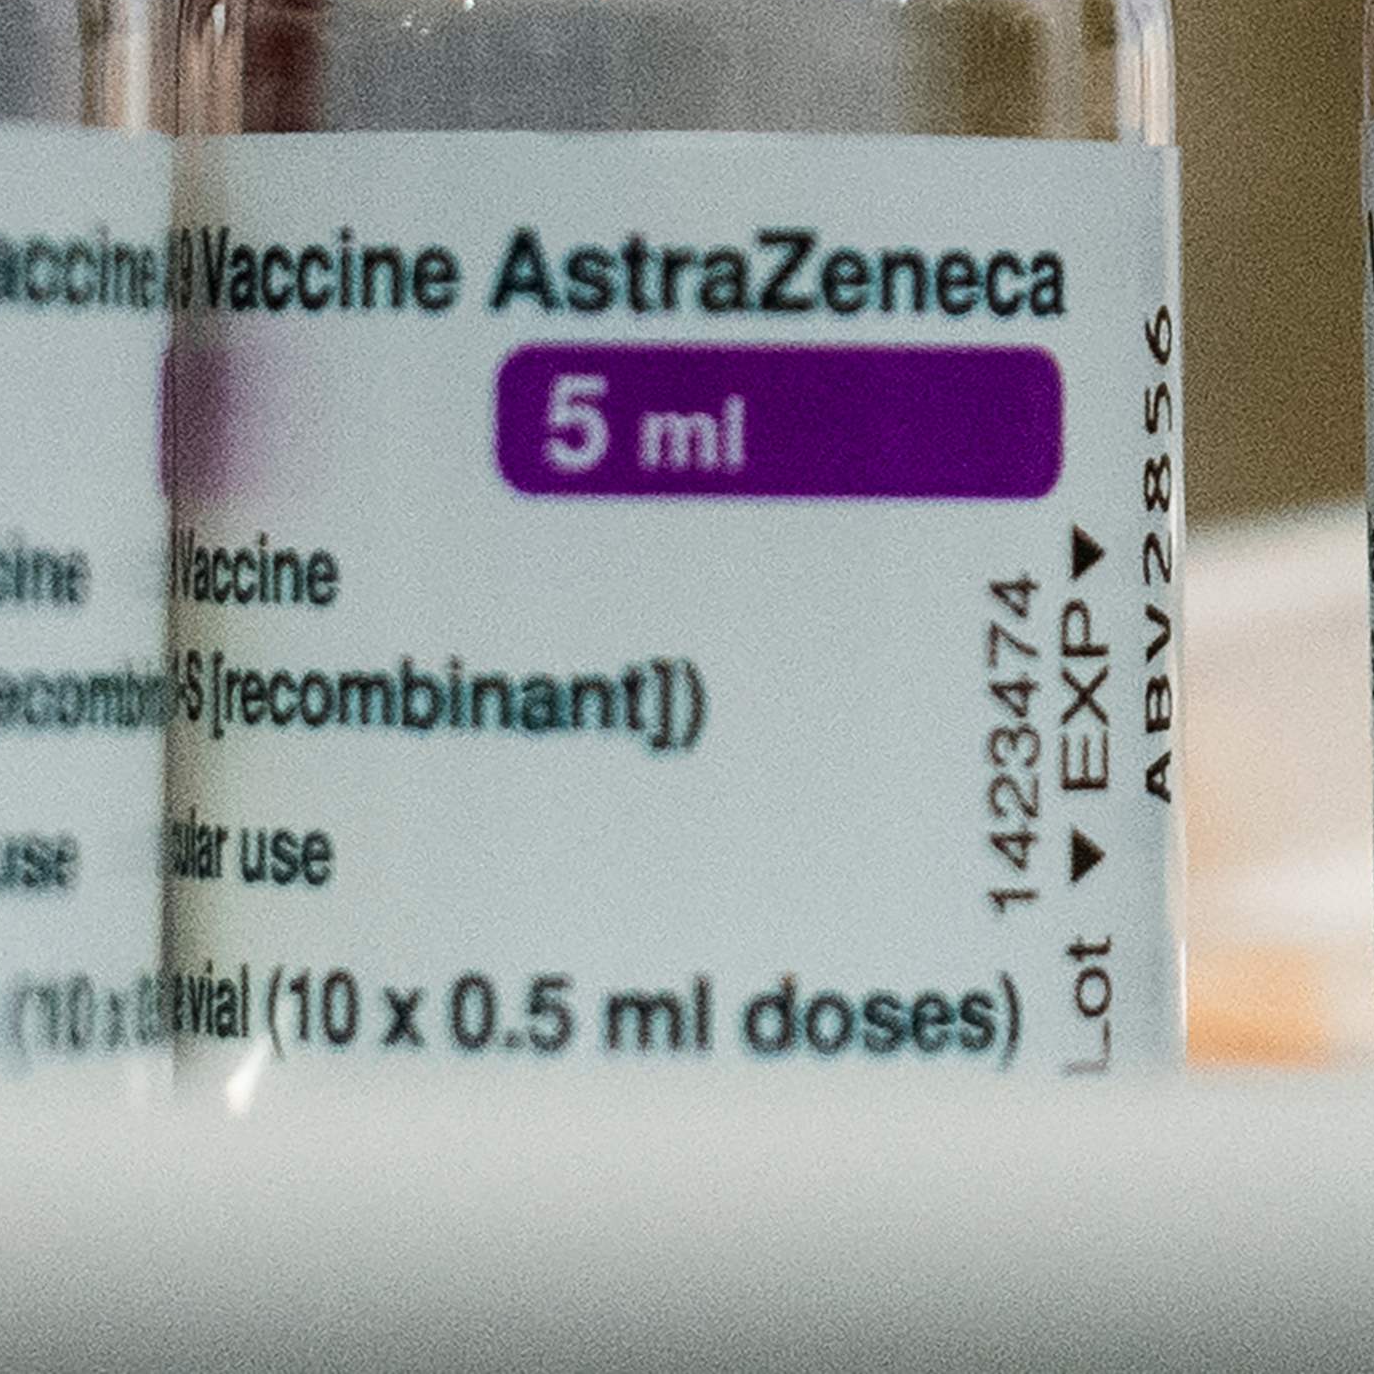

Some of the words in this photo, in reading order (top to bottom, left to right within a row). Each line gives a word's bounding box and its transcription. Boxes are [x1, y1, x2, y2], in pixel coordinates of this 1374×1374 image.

[201, 224, 462, 314] Vaccine
[488, 226, 1067, 320] AstraZeneca
[544, 372, 610, 474] 5
[637, 394, 747, 472] ml
[177, 530, 340, 606] Vaccine
[1141, 304, 1175, 805] ABV2856
[212, 647, 708, 753] [recombinant])
[985, 573, 1043, 915] 1423474
[1059, 597, 1111, 794] EXP
[238, 827, 335, 887] use
[188, 959, 251, 1039] vial
[266, 963, 361, 1061] (10
[381, 988, 425, 1048] x
[446, 970, 576, 1055] 0.5
[602, 975, 713, 1053] ml
[740, 972, 1024, 1067] doses)
[1063, 935, 1113, 1076] Lot
